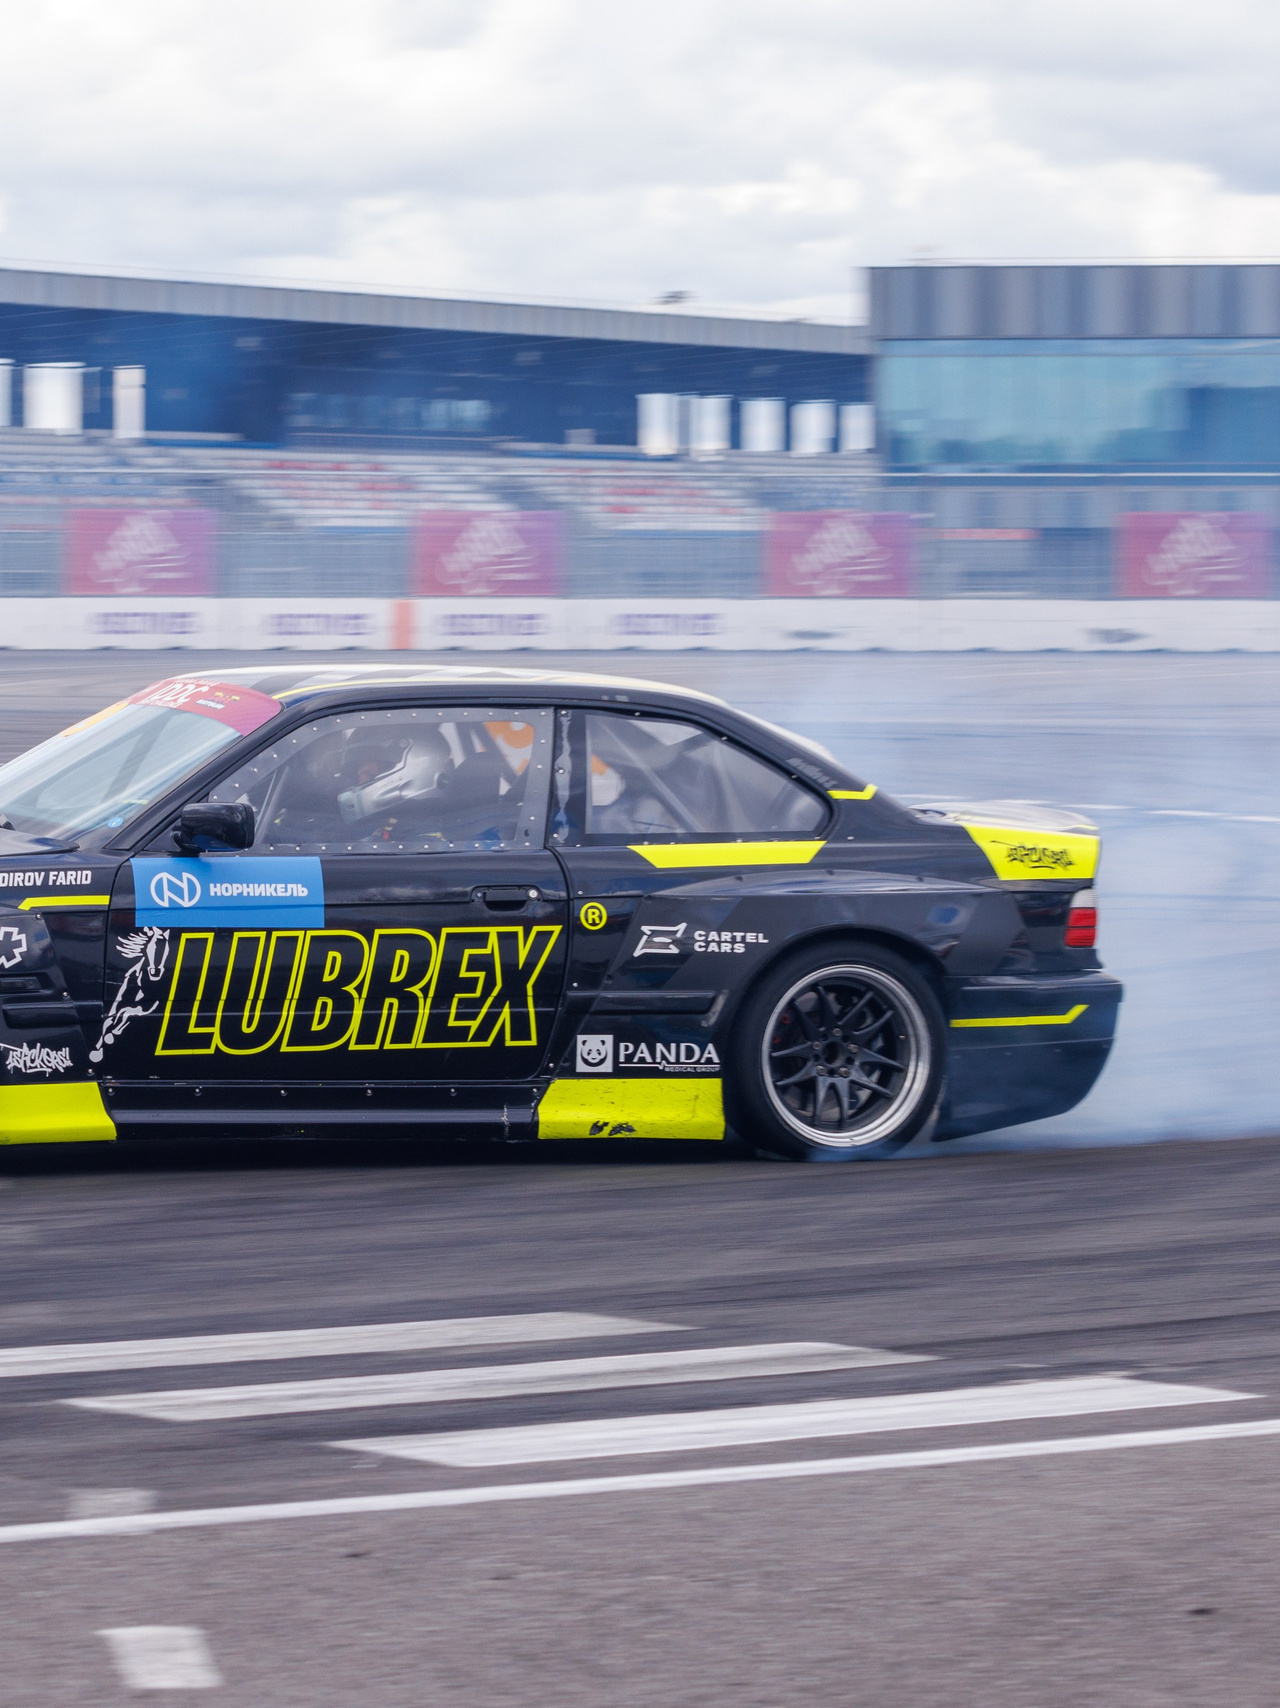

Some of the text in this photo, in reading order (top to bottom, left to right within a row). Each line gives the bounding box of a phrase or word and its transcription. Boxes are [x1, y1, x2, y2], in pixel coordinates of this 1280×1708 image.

[48, 870, 93, 886] FARID
[209, 883, 309, 897] НОРНИКЕЛЬ
[693, 930, 770, 943] CARTEL
[693, 942, 746, 953] CARS
[154, 924, 563, 1055] LUBREX
[619, 1042, 720, 1063] PANDA
